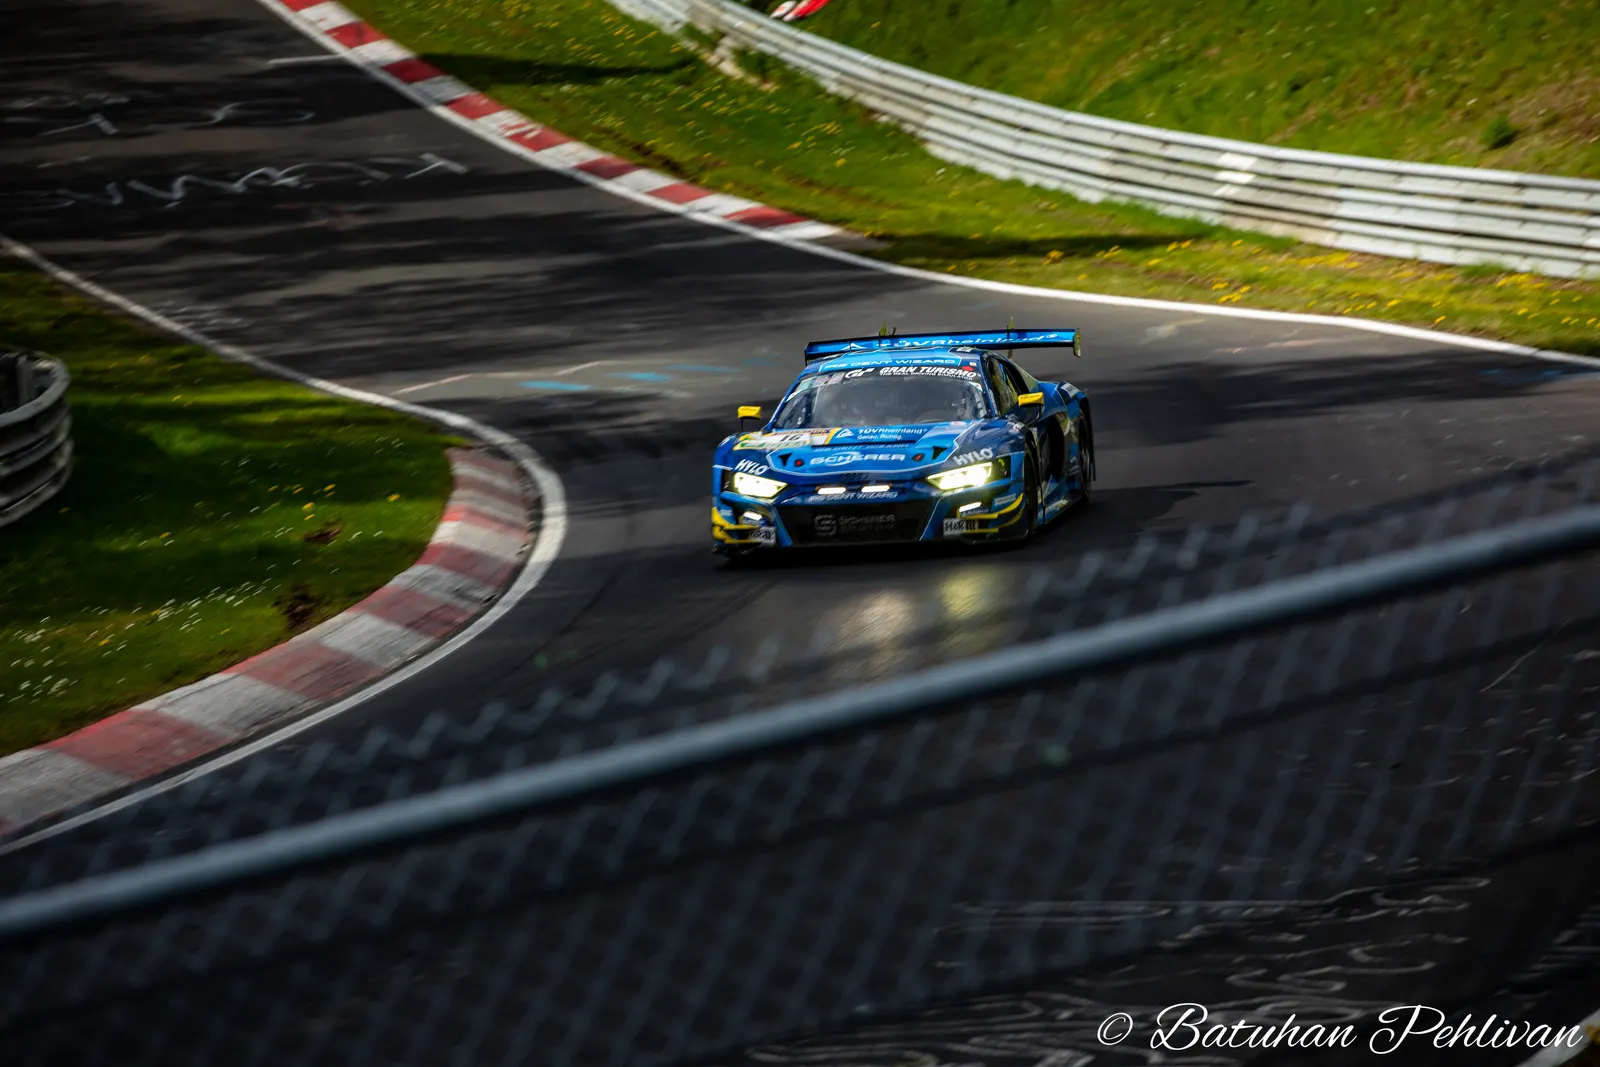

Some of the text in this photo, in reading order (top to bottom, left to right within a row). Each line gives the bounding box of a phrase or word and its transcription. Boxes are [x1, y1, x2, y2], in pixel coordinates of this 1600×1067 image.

[879, 366, 978, 378] GRAN TURISMO
[810, 452, 906, 465] SCHERER
[953, 447, 994, 466] HYLO
[734, 458, 769, 475] HYLO
